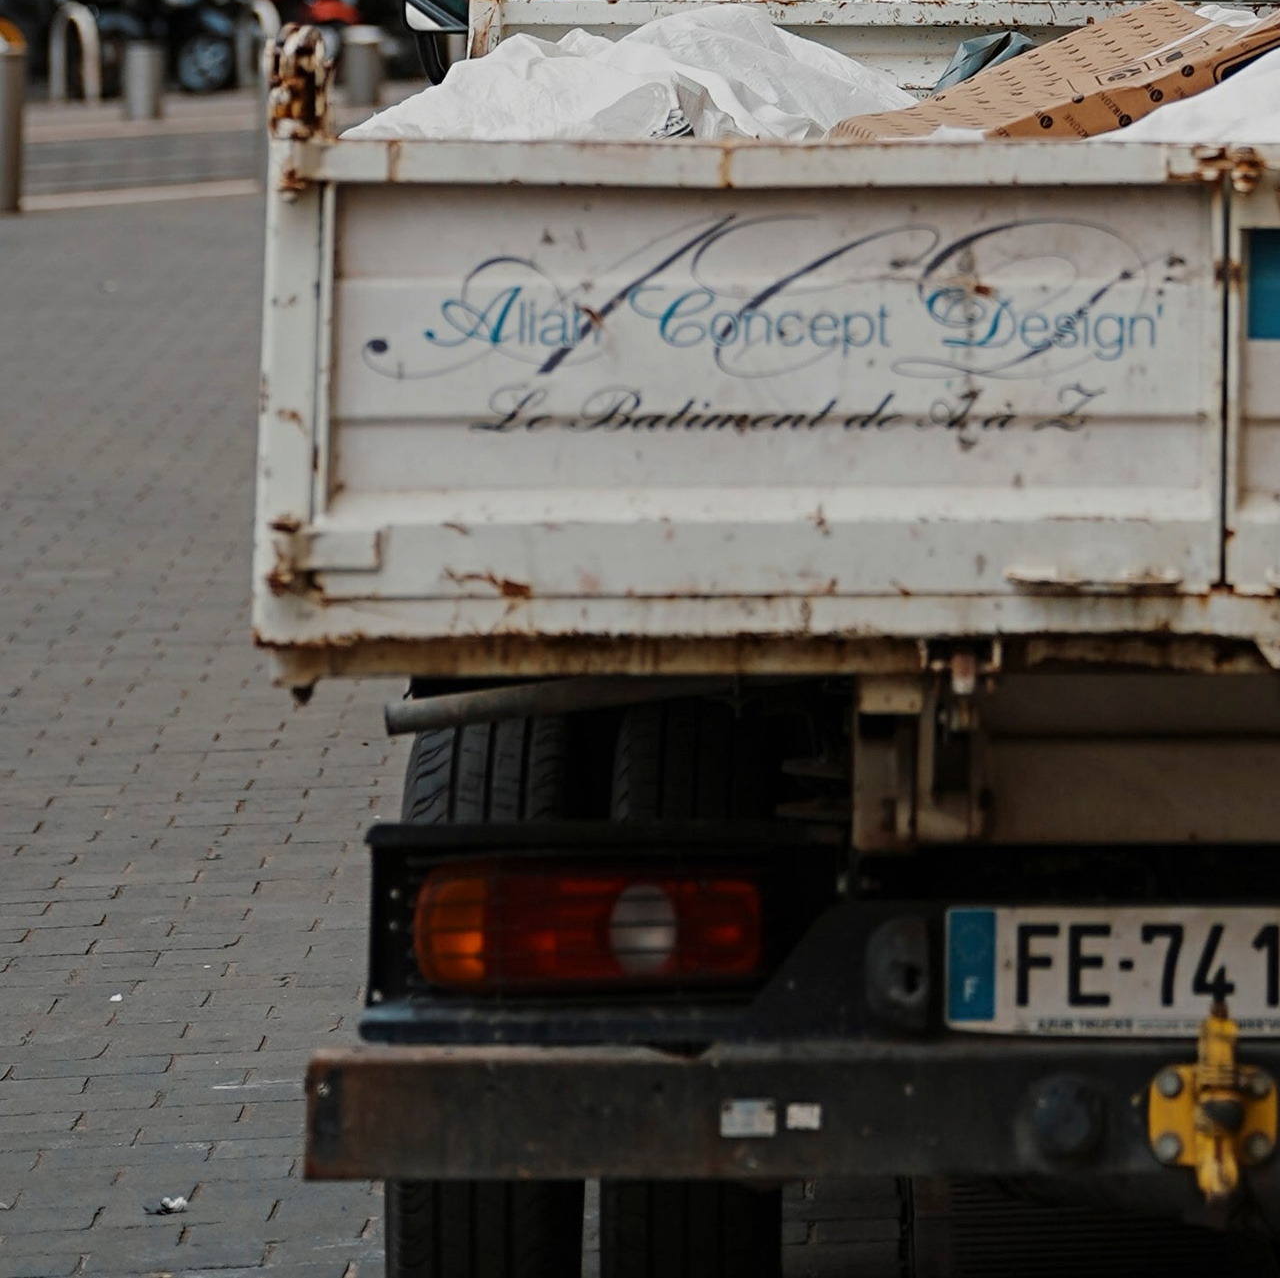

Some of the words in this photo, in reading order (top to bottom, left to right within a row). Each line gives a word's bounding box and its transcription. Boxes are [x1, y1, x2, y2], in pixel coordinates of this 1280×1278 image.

[628, 284, 890, 358] Concept
[468, 383, 551, 433] Le
[843, 391, 903, 430] de
